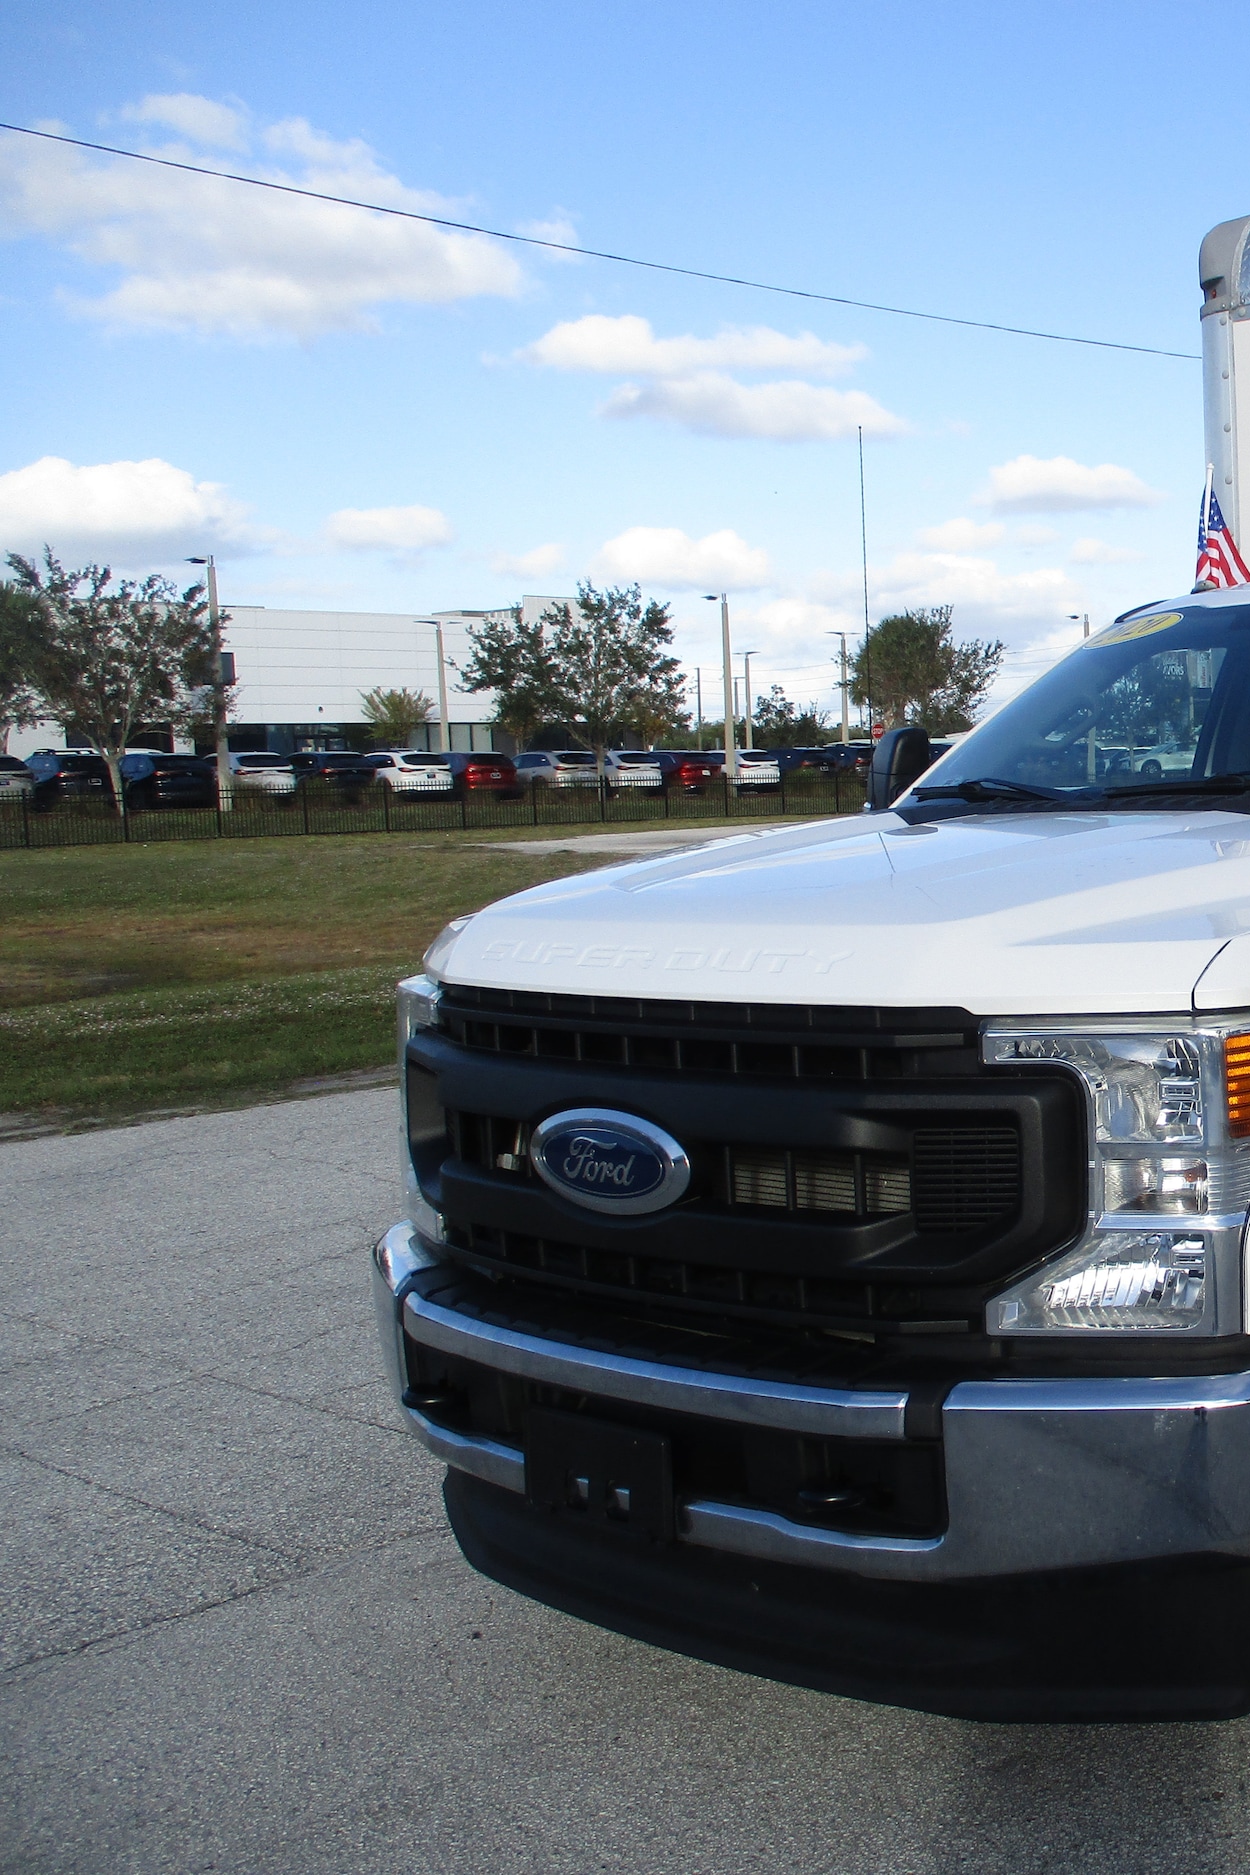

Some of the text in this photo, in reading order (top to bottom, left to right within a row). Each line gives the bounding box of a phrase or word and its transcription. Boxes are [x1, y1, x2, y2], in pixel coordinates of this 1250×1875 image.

[481, 939, 855, 975] SUPER DUTY
[563, 1136, 636, 1187] Ford
